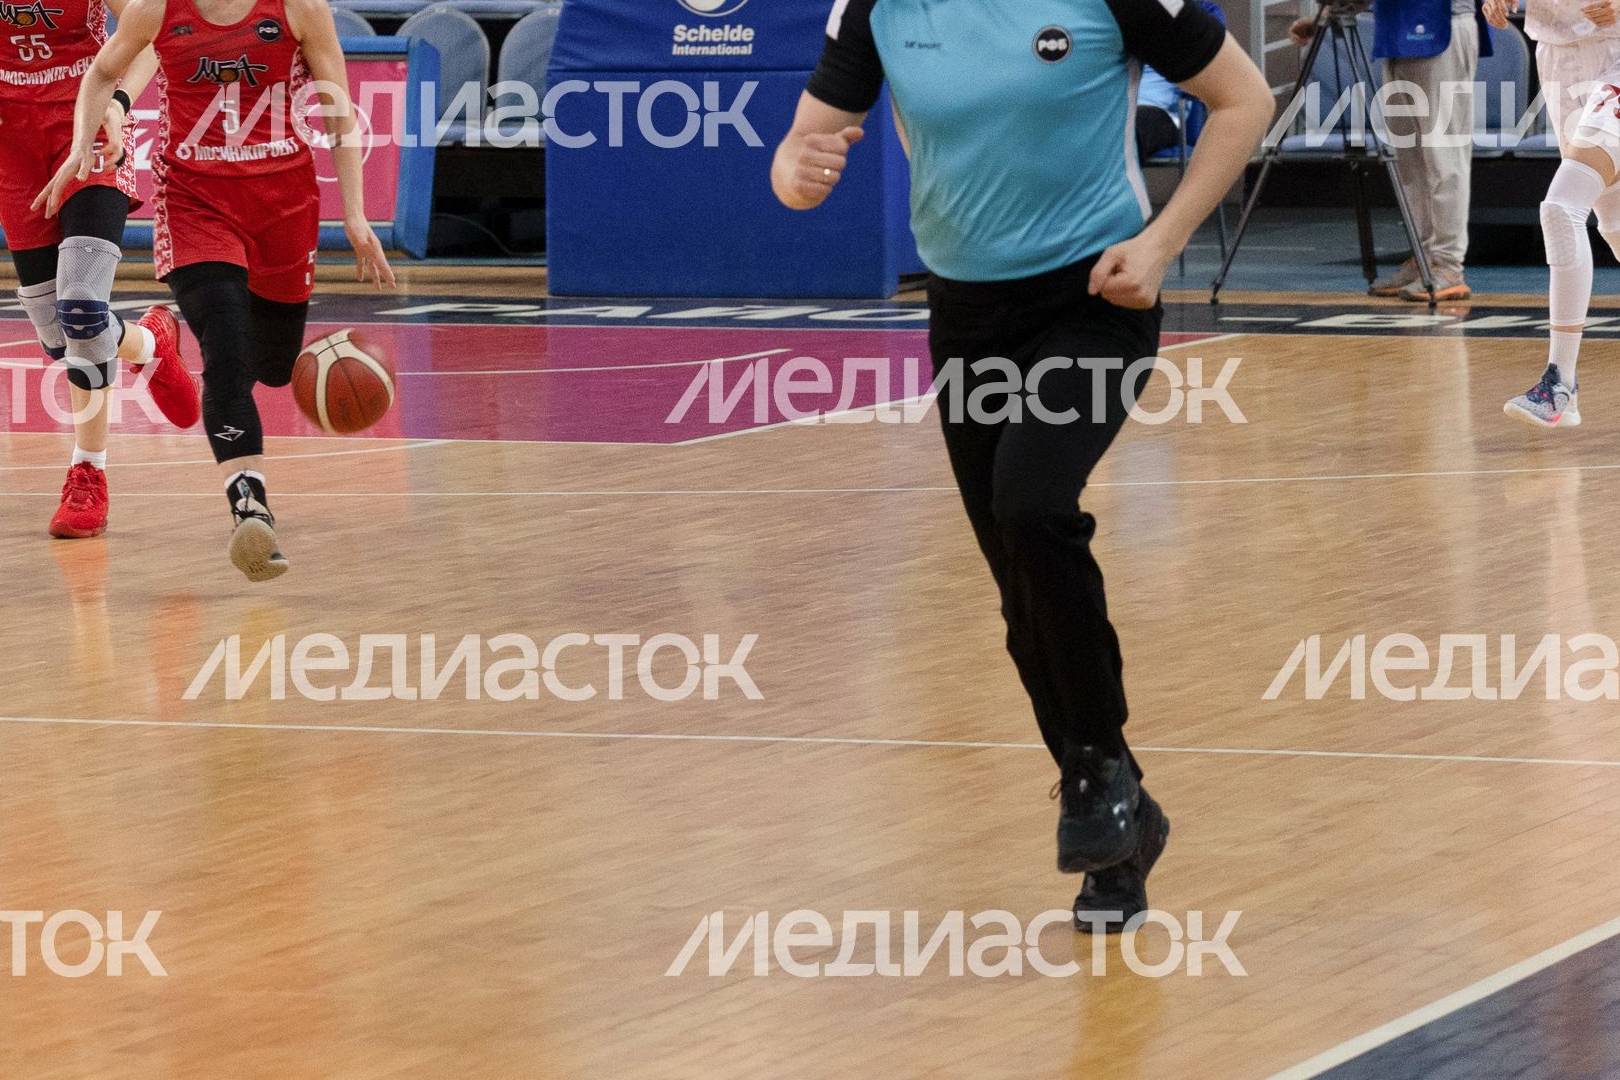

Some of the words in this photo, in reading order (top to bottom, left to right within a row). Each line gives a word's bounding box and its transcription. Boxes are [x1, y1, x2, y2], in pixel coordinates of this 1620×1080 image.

[673, 24, 755, 42] Schelde
[10, 34, 53, 61] 55
[671, 44, 753, 55] International
[219, 100, 240, 134] 5
[374, 303, 930, 321] РАЙО
